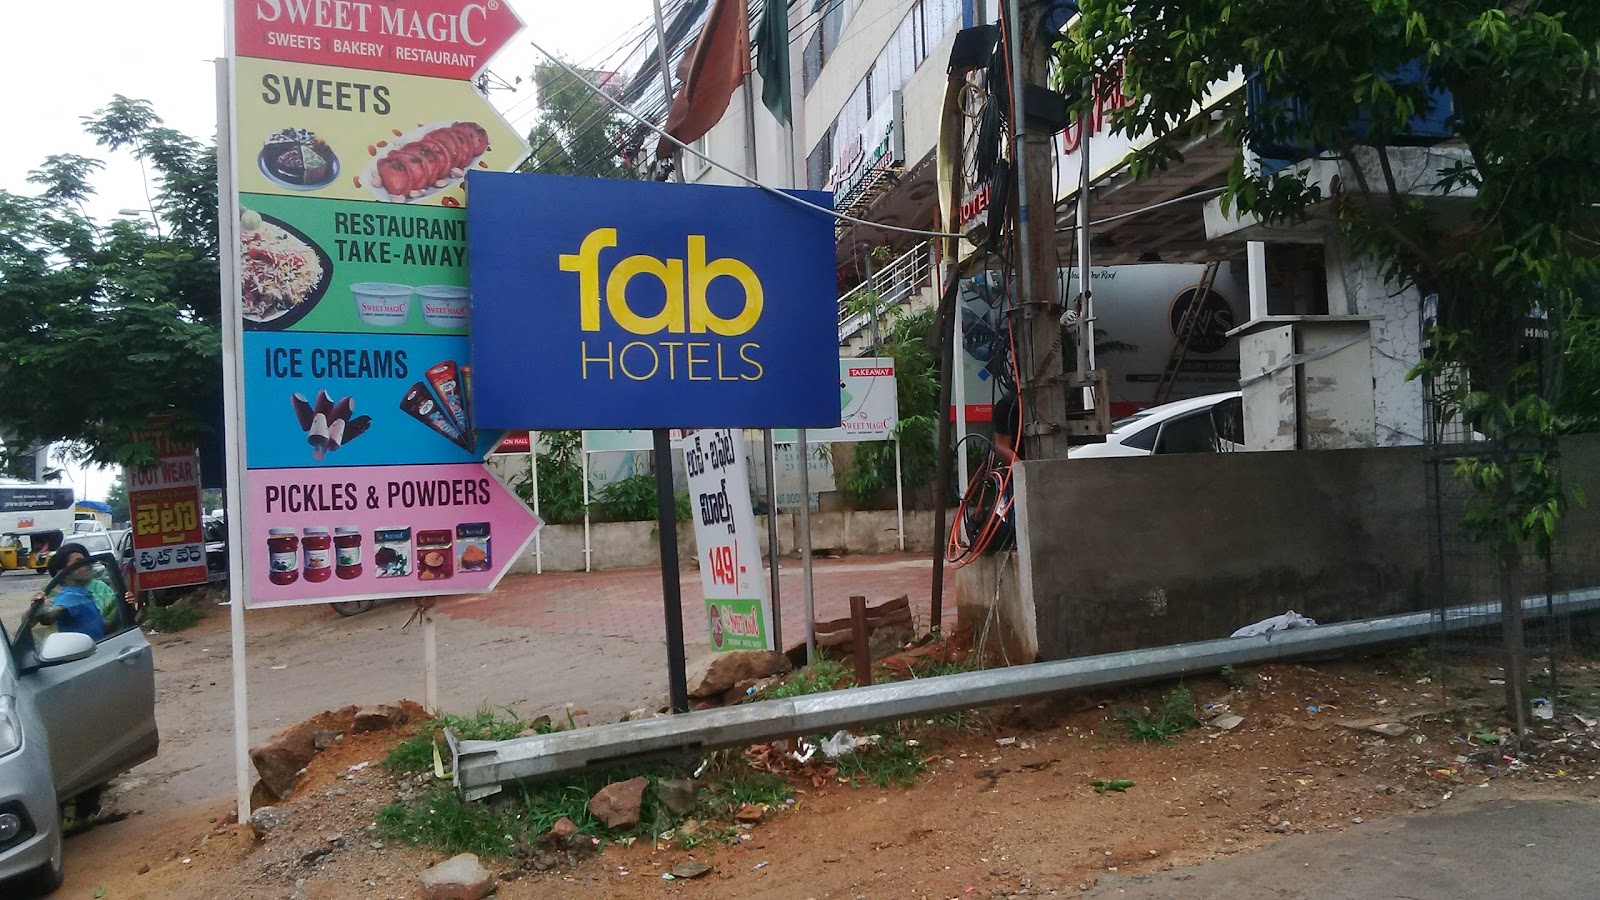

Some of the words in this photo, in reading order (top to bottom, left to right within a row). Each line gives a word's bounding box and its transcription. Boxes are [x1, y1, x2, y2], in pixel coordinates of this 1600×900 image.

[257, 0, 372, 33] SWEET
[379, 2, 487, 46] MAGIC
[267, 31, 321, 51] SWEETS
[333, 39, 384, 58] BAKERY
[395, 46, 477, 68] RESTAURANT
[261, 73, 392, 116] SWEETS
[334, 211, 467, 242] RESTAURANT
[335, 239, 467, 268] TAKE-AWAY
[559, 227, 764, 336] fab
[1525, 327, 1549, 339] HMR
[265, 348, 303, 378] ICE
[311, 349, 408, 379] CREAMS
[581, 341, 763, 381] HOTELS
[851, 368, 890, 376] TAKEAWAY
[842, 420, 865, 430] SWEET
[866, 418, 891, 430] MAGIC
[162, 461, 193, 483] WEAR
[265, 482, 358, 514] PICKLES
[366, 485, 380, 509] &
[387, 478, 491, 509] POWDERS
[708, 538, 747, 596] 149/-
